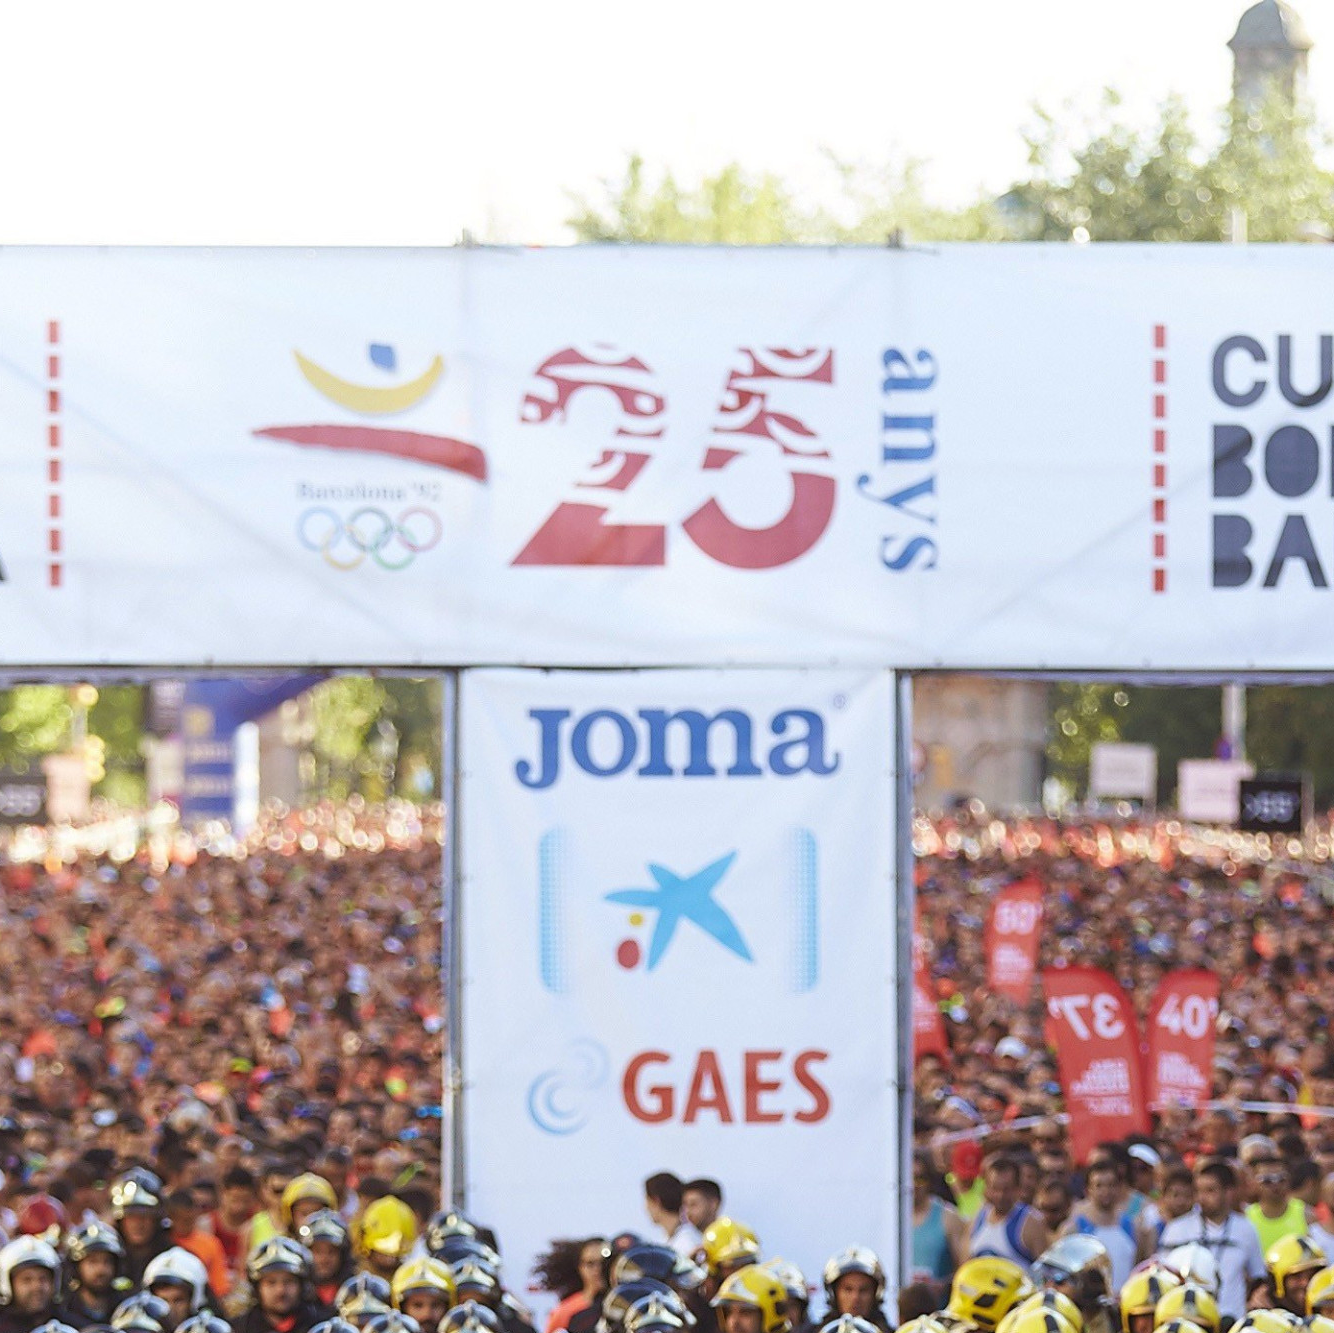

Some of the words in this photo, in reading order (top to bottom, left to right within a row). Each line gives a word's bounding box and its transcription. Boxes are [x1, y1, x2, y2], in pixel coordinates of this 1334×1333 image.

[510, 344, 836, 569] 25
[856, 345, 940, 574] anys
[621, 1049, 832, 1126] GAES
